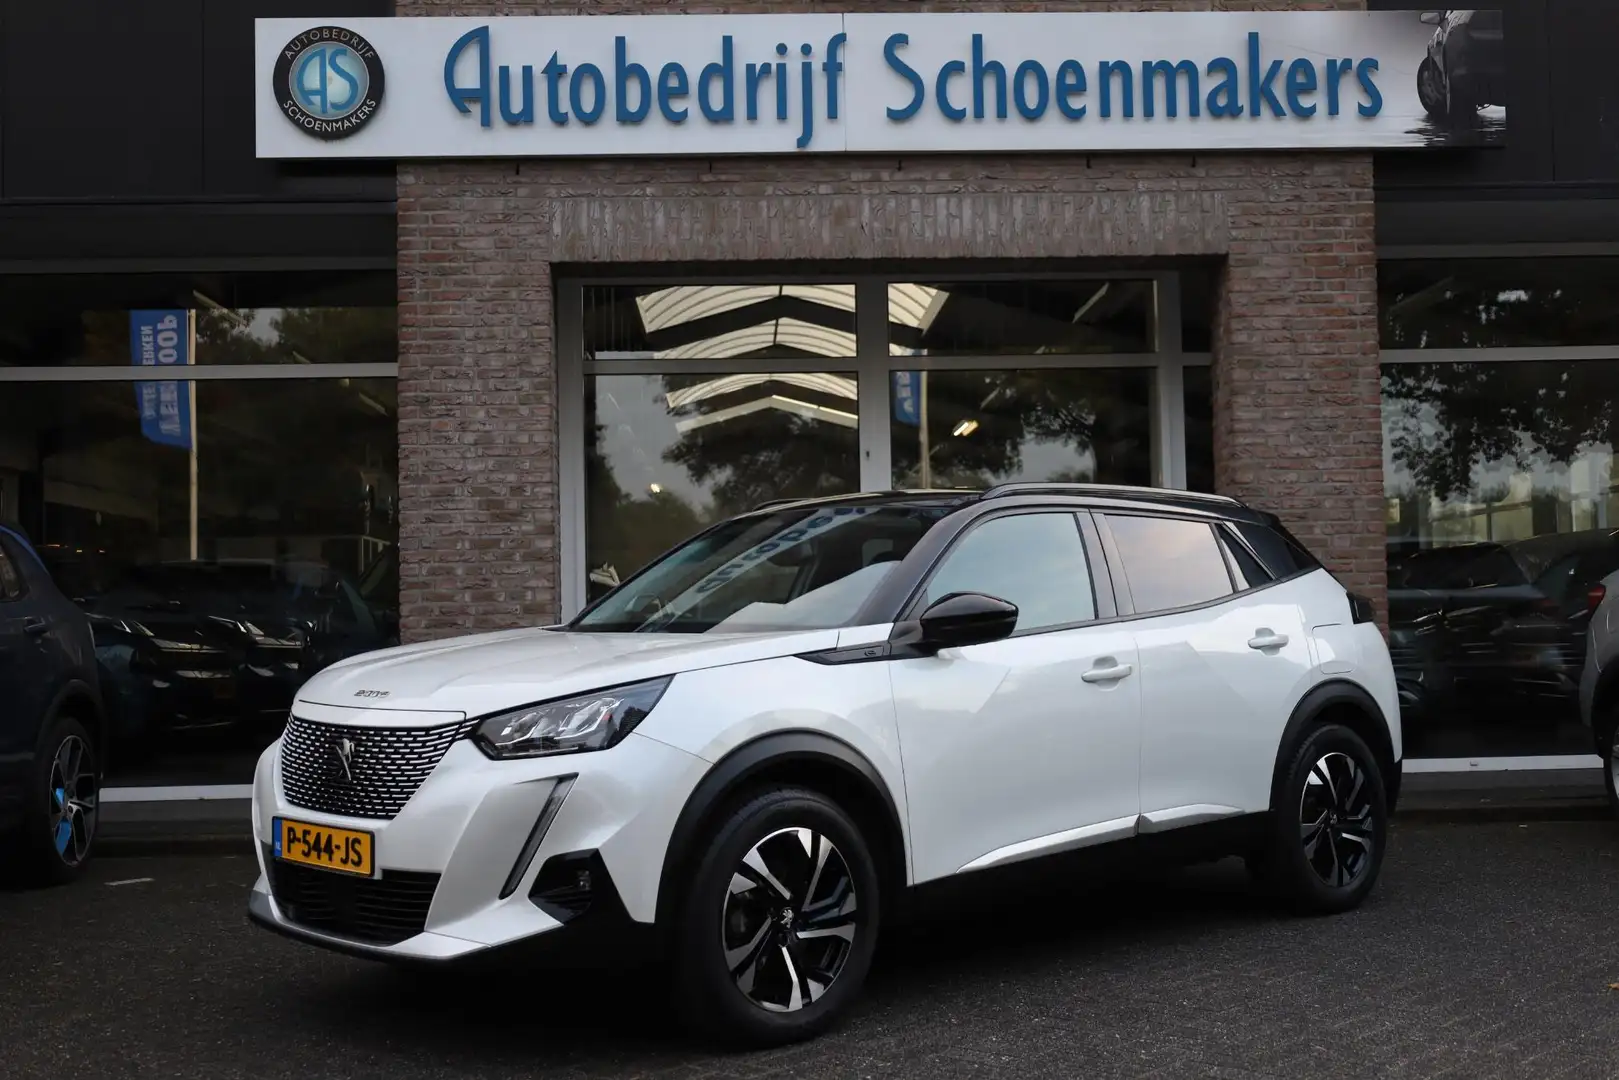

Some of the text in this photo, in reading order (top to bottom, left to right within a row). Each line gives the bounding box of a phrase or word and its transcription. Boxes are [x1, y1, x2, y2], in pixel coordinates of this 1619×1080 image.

[285, 29, 374, 60] AUTOBEDRIJF
[297, 47, 358, 114] AS
[444, 25, 1383, 148] Autobedrijf Schoenmakers
[284, 98, 375, 133] SCHOENMAKERS
[286, 826, 362, 867] P-544-JS
